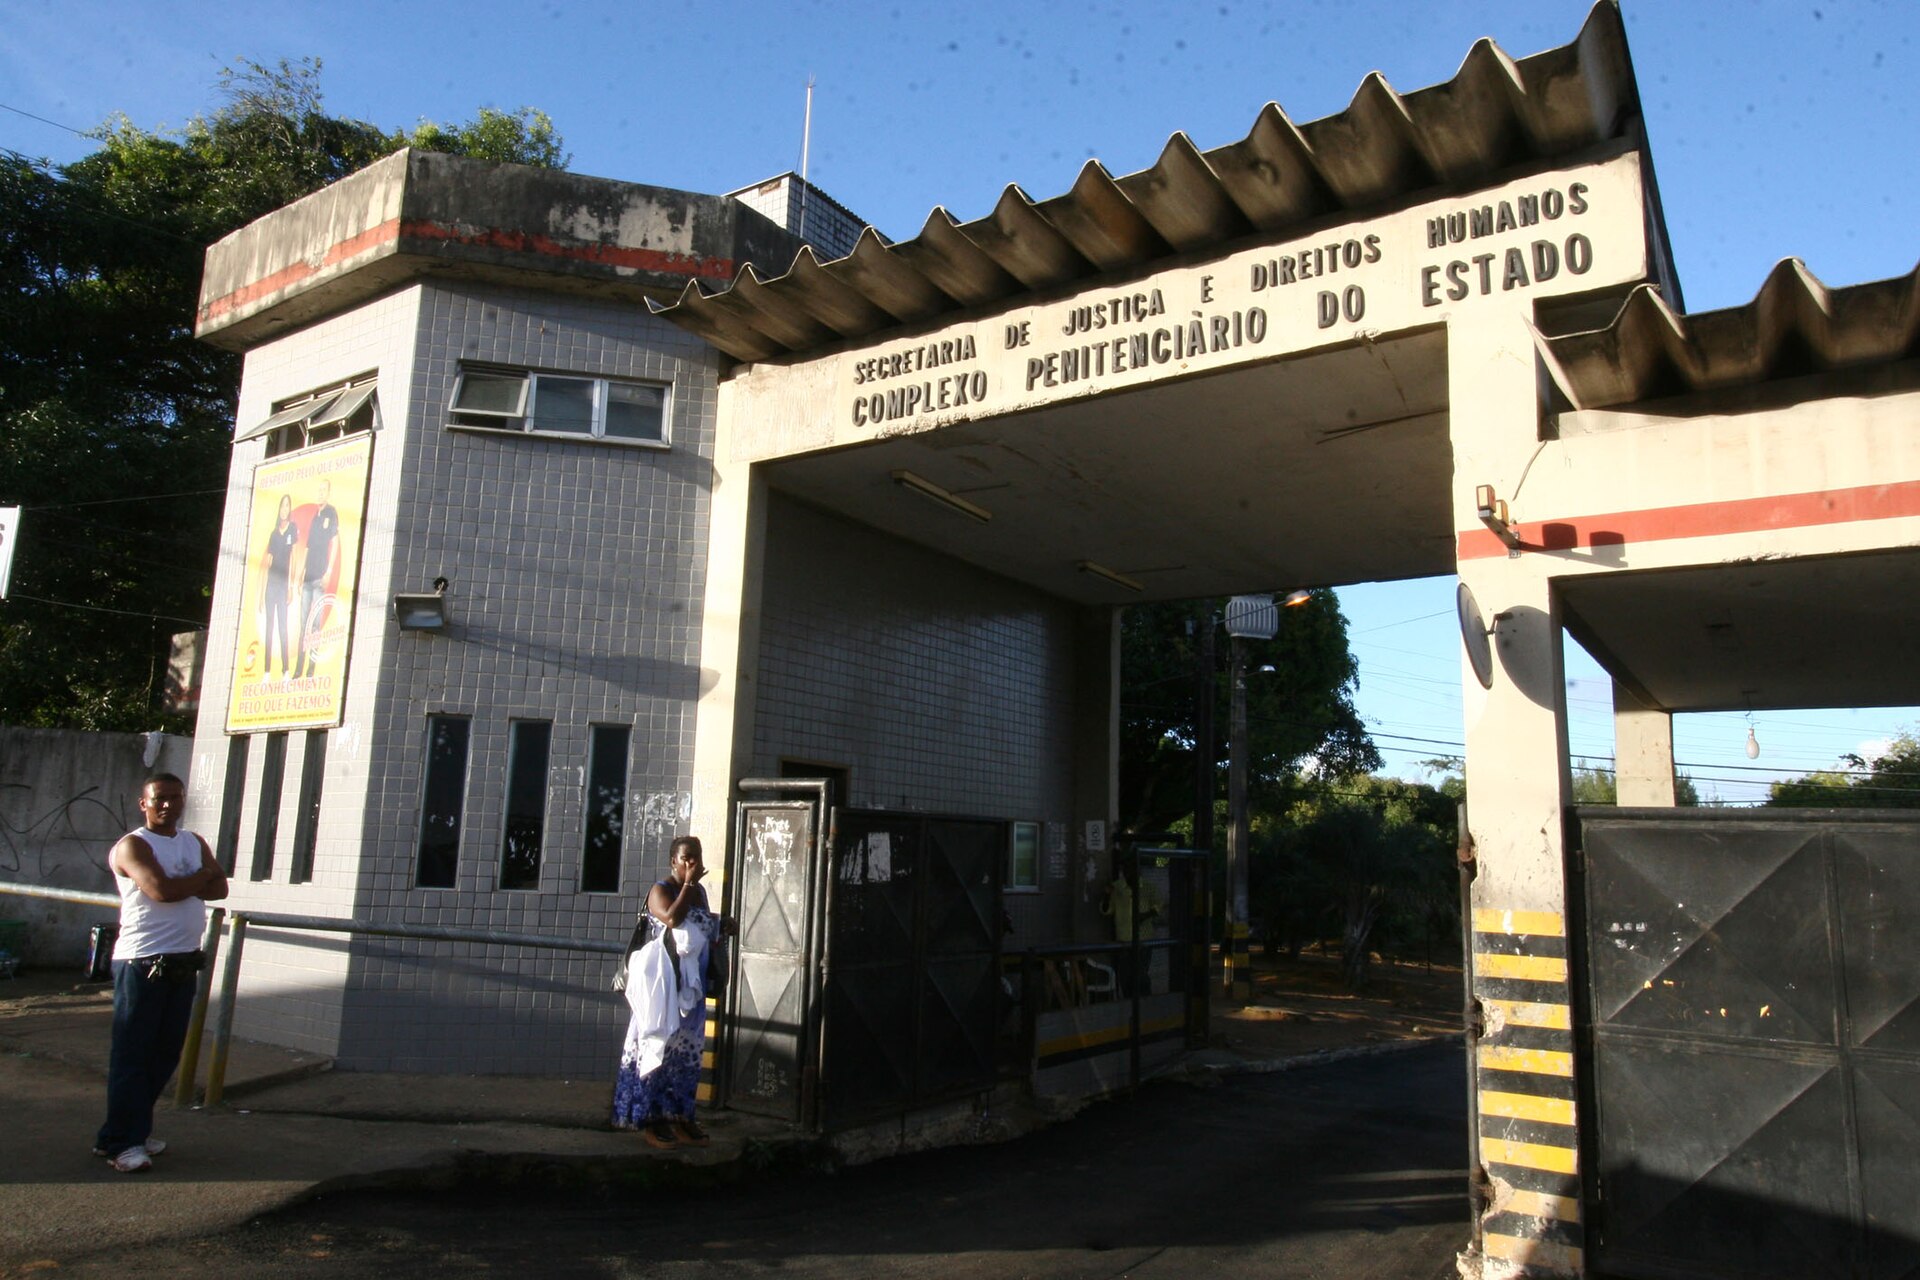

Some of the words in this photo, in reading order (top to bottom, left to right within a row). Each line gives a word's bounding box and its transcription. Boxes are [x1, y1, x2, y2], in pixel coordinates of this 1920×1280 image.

[852, 369, 988, 427] COMPLEXO
[1317, 284, 1366, 329] DO
[1421, 232, 1593, 307] ESTADO
[853, 334, 977, 385] SECRETARIA
[1004, 320, 1031, 350] DE
[1062, 288, 1166, 336] JUSTIÇA
[1200, 274, 1214, 304] E
[1250, 234, 1382, 292] DIREITOS
[1426, 182, 1589, 249] HUMANOS
[239, 700, 261, 714] PELO
[264, 698, 283, 712] QUE
[286, 694, 331, 710] FAZEMOS
[242, 676, 331, 697] RECONHECIMENTO
